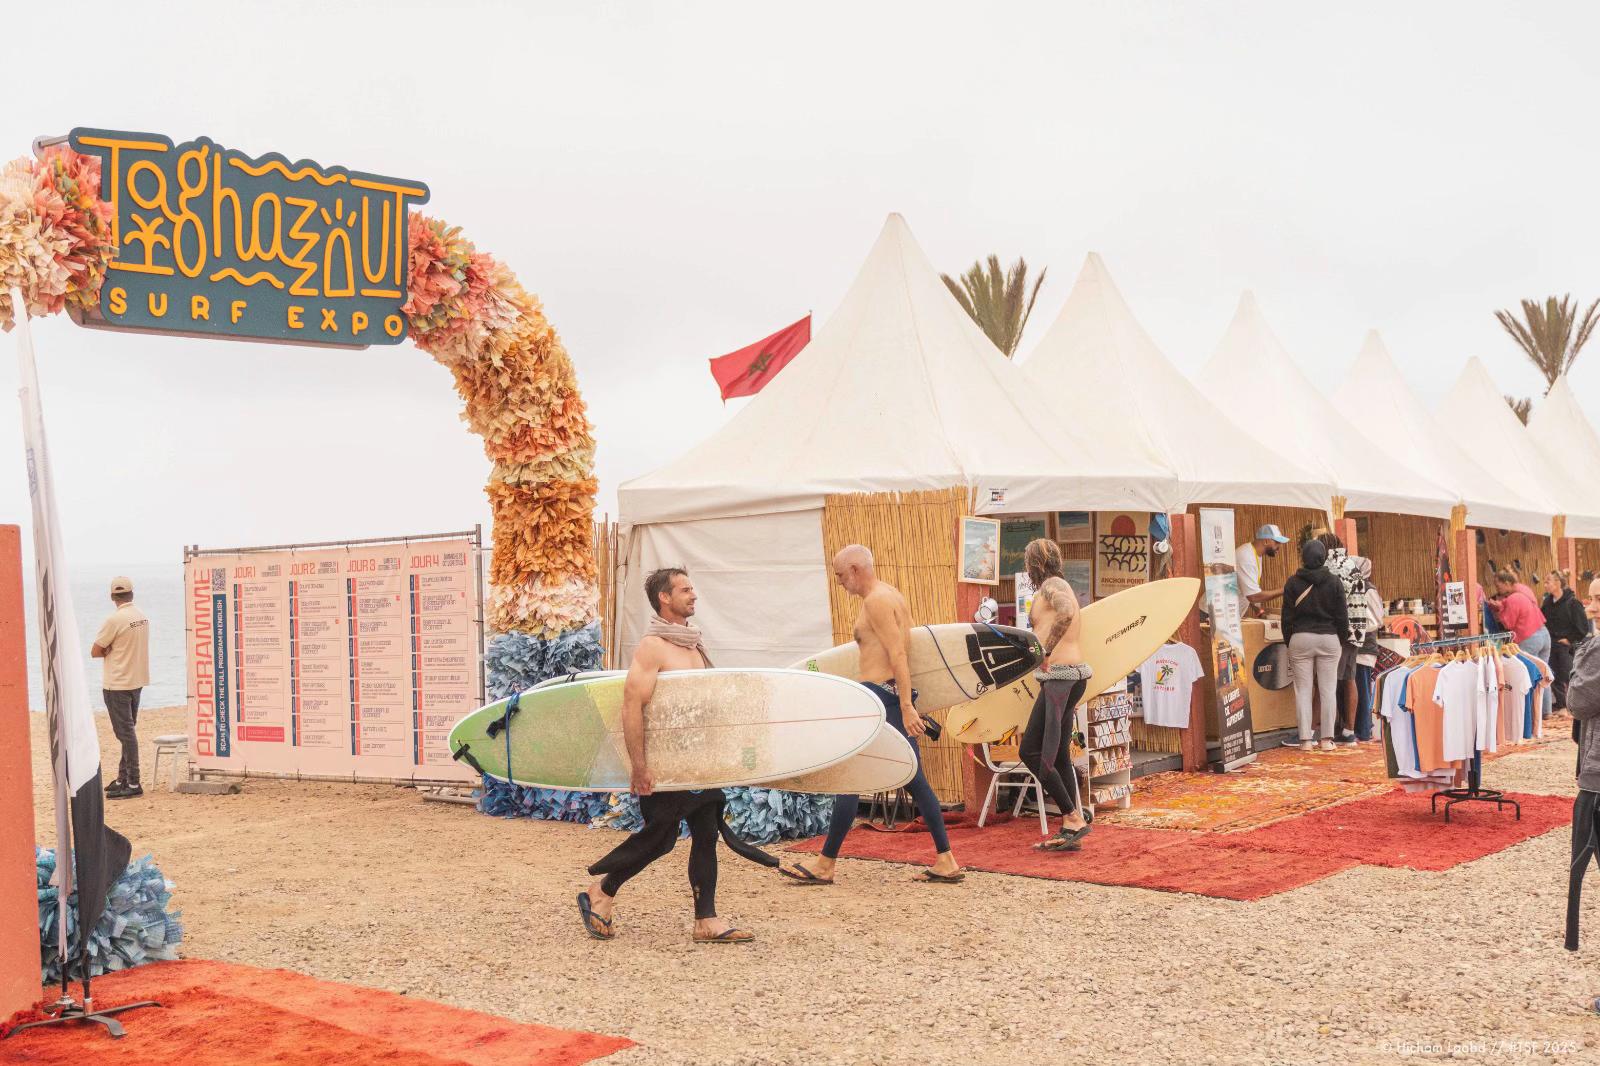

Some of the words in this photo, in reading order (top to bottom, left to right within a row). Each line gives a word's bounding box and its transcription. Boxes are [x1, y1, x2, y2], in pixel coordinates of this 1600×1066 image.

[109, 286, 247, 324] SURF
[287, 305, 403, 337] EXPO
[347, 559, 368, 572] JOUR
[410, 555, 432, 568] JOUR
[234, 567, 252, 579] JOUR
[289, 563, 309, 575] JOUR
[193, 568, 214, 757] PROGRAMME
[220, 722, 227, 731] TO
